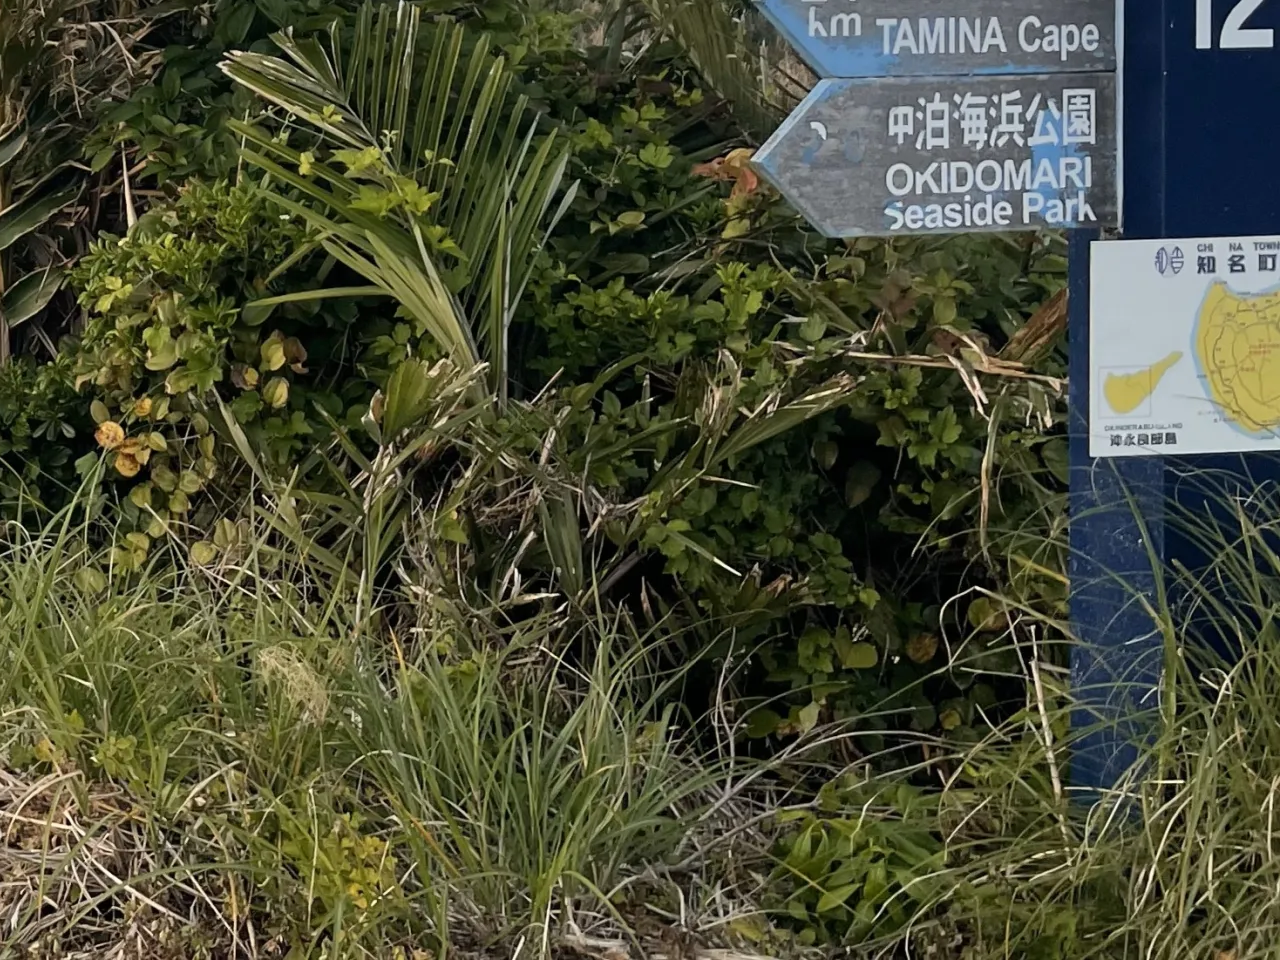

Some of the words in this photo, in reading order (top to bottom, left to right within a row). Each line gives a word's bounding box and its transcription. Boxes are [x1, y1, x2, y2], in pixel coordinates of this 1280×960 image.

[808, 6, 862, 38] km
[876, 16, 1007, 56] TAMINA
[1018, 15, 1100, 61] Cape
[885, 156, 1092, 196] OKIDOMARI
[884, 195, 1013, 230] Seaside
[1022, 191, 1097, 225] Park
[1196, 253, 1277, 274] 知名町
